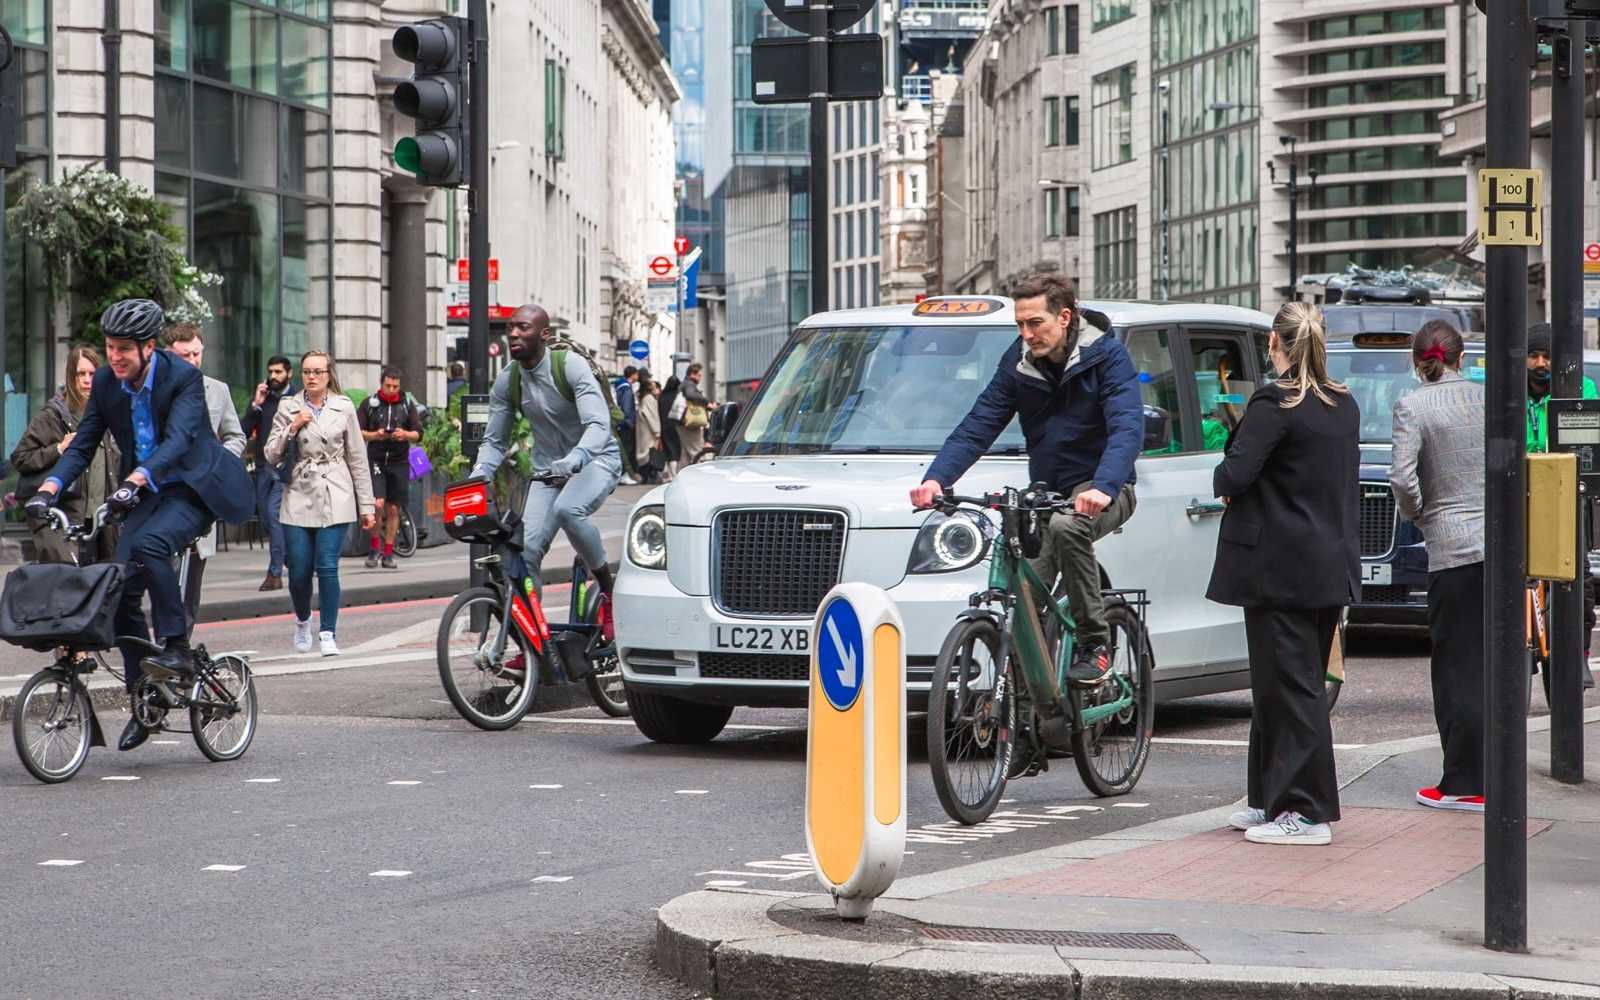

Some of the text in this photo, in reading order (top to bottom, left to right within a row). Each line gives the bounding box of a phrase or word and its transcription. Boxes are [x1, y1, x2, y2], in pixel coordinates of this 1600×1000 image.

[1501, 184, 1522, 195] 100
[1509, 220, 1515, 230] 1
[926, 303, 984, 312] TAXI
[716, 626, 809, 651] LC22 XB
